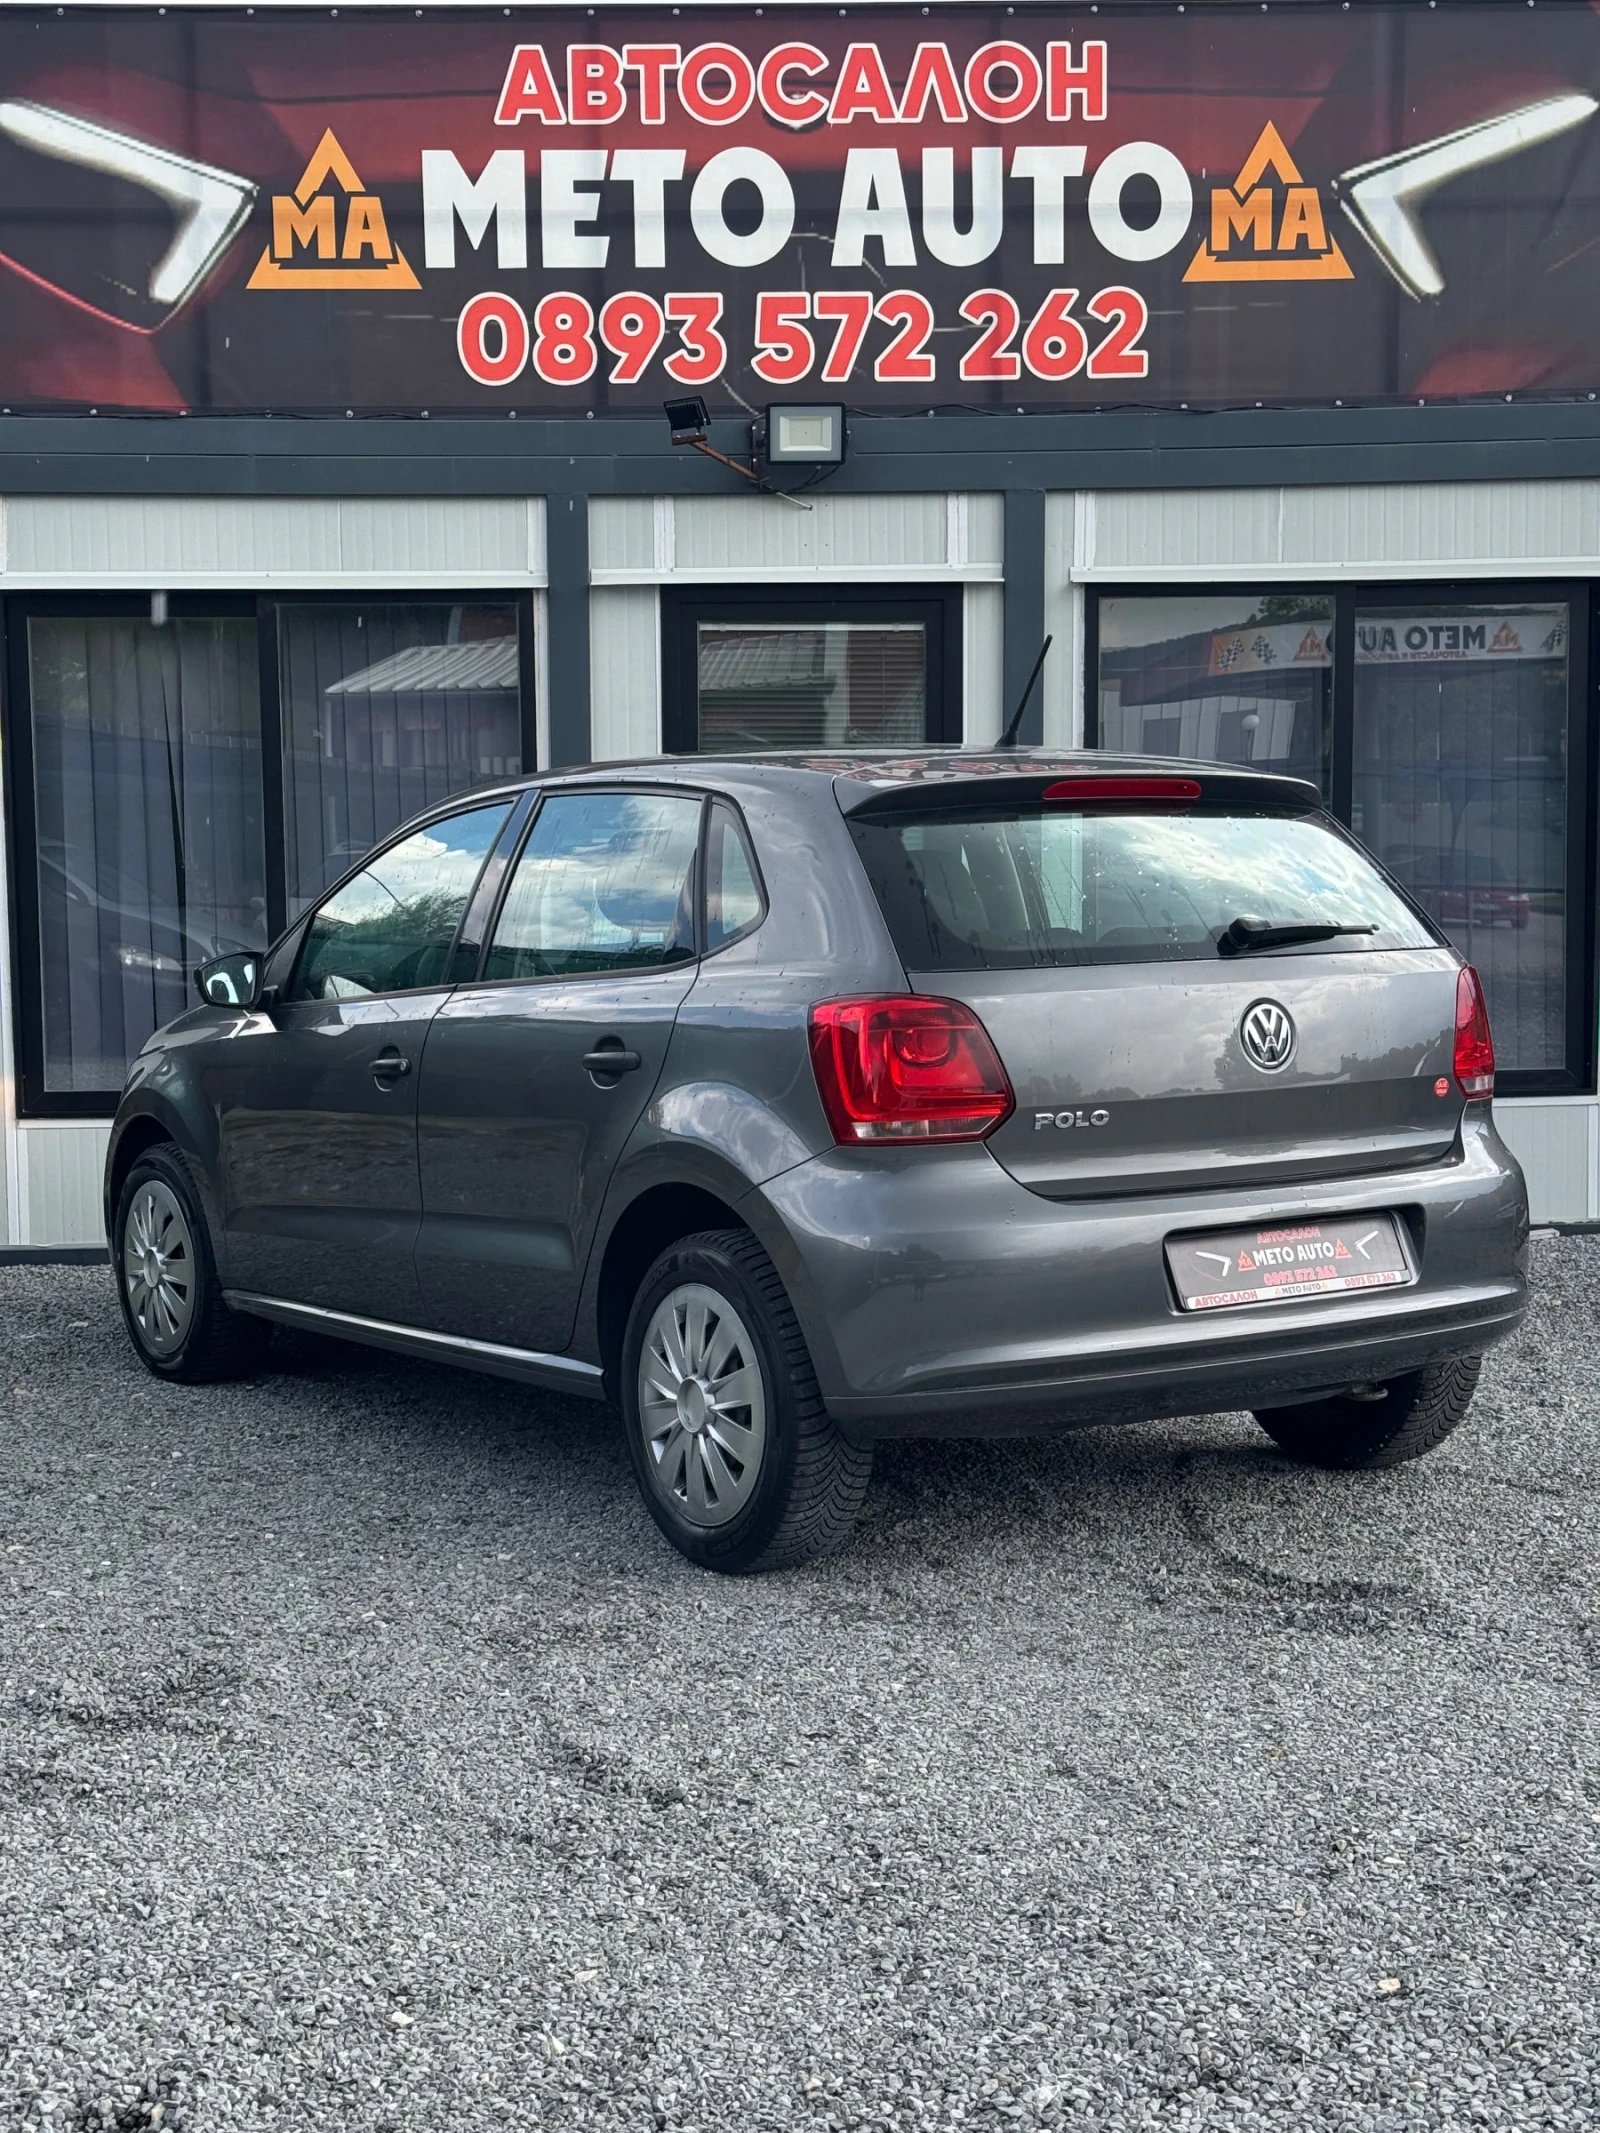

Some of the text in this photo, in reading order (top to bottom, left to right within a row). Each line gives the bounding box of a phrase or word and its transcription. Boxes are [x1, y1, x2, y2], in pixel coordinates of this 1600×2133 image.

[494, 40, 1108, 126] АВТОСАЛОН
[421, 141, 1194, 269] METO AUTO
[457, 286, 1148, 386] 0893 572 262
[1034, 1109, 1110, 1131] POLO
[1257, 1226, 1321, 1244] АВТОСАЛОН
[1252, 1241, 1335, 1267] METO AUTO
[1263, 1265, 1338, 1286] 0893 572 262
[1344, 1272, 1397, 1287] 0893 572 262
[1195, 1290, 1258, 1307] АВТОСАЛОН
[1281, 1282, 1321, 1295] METO AUTO
